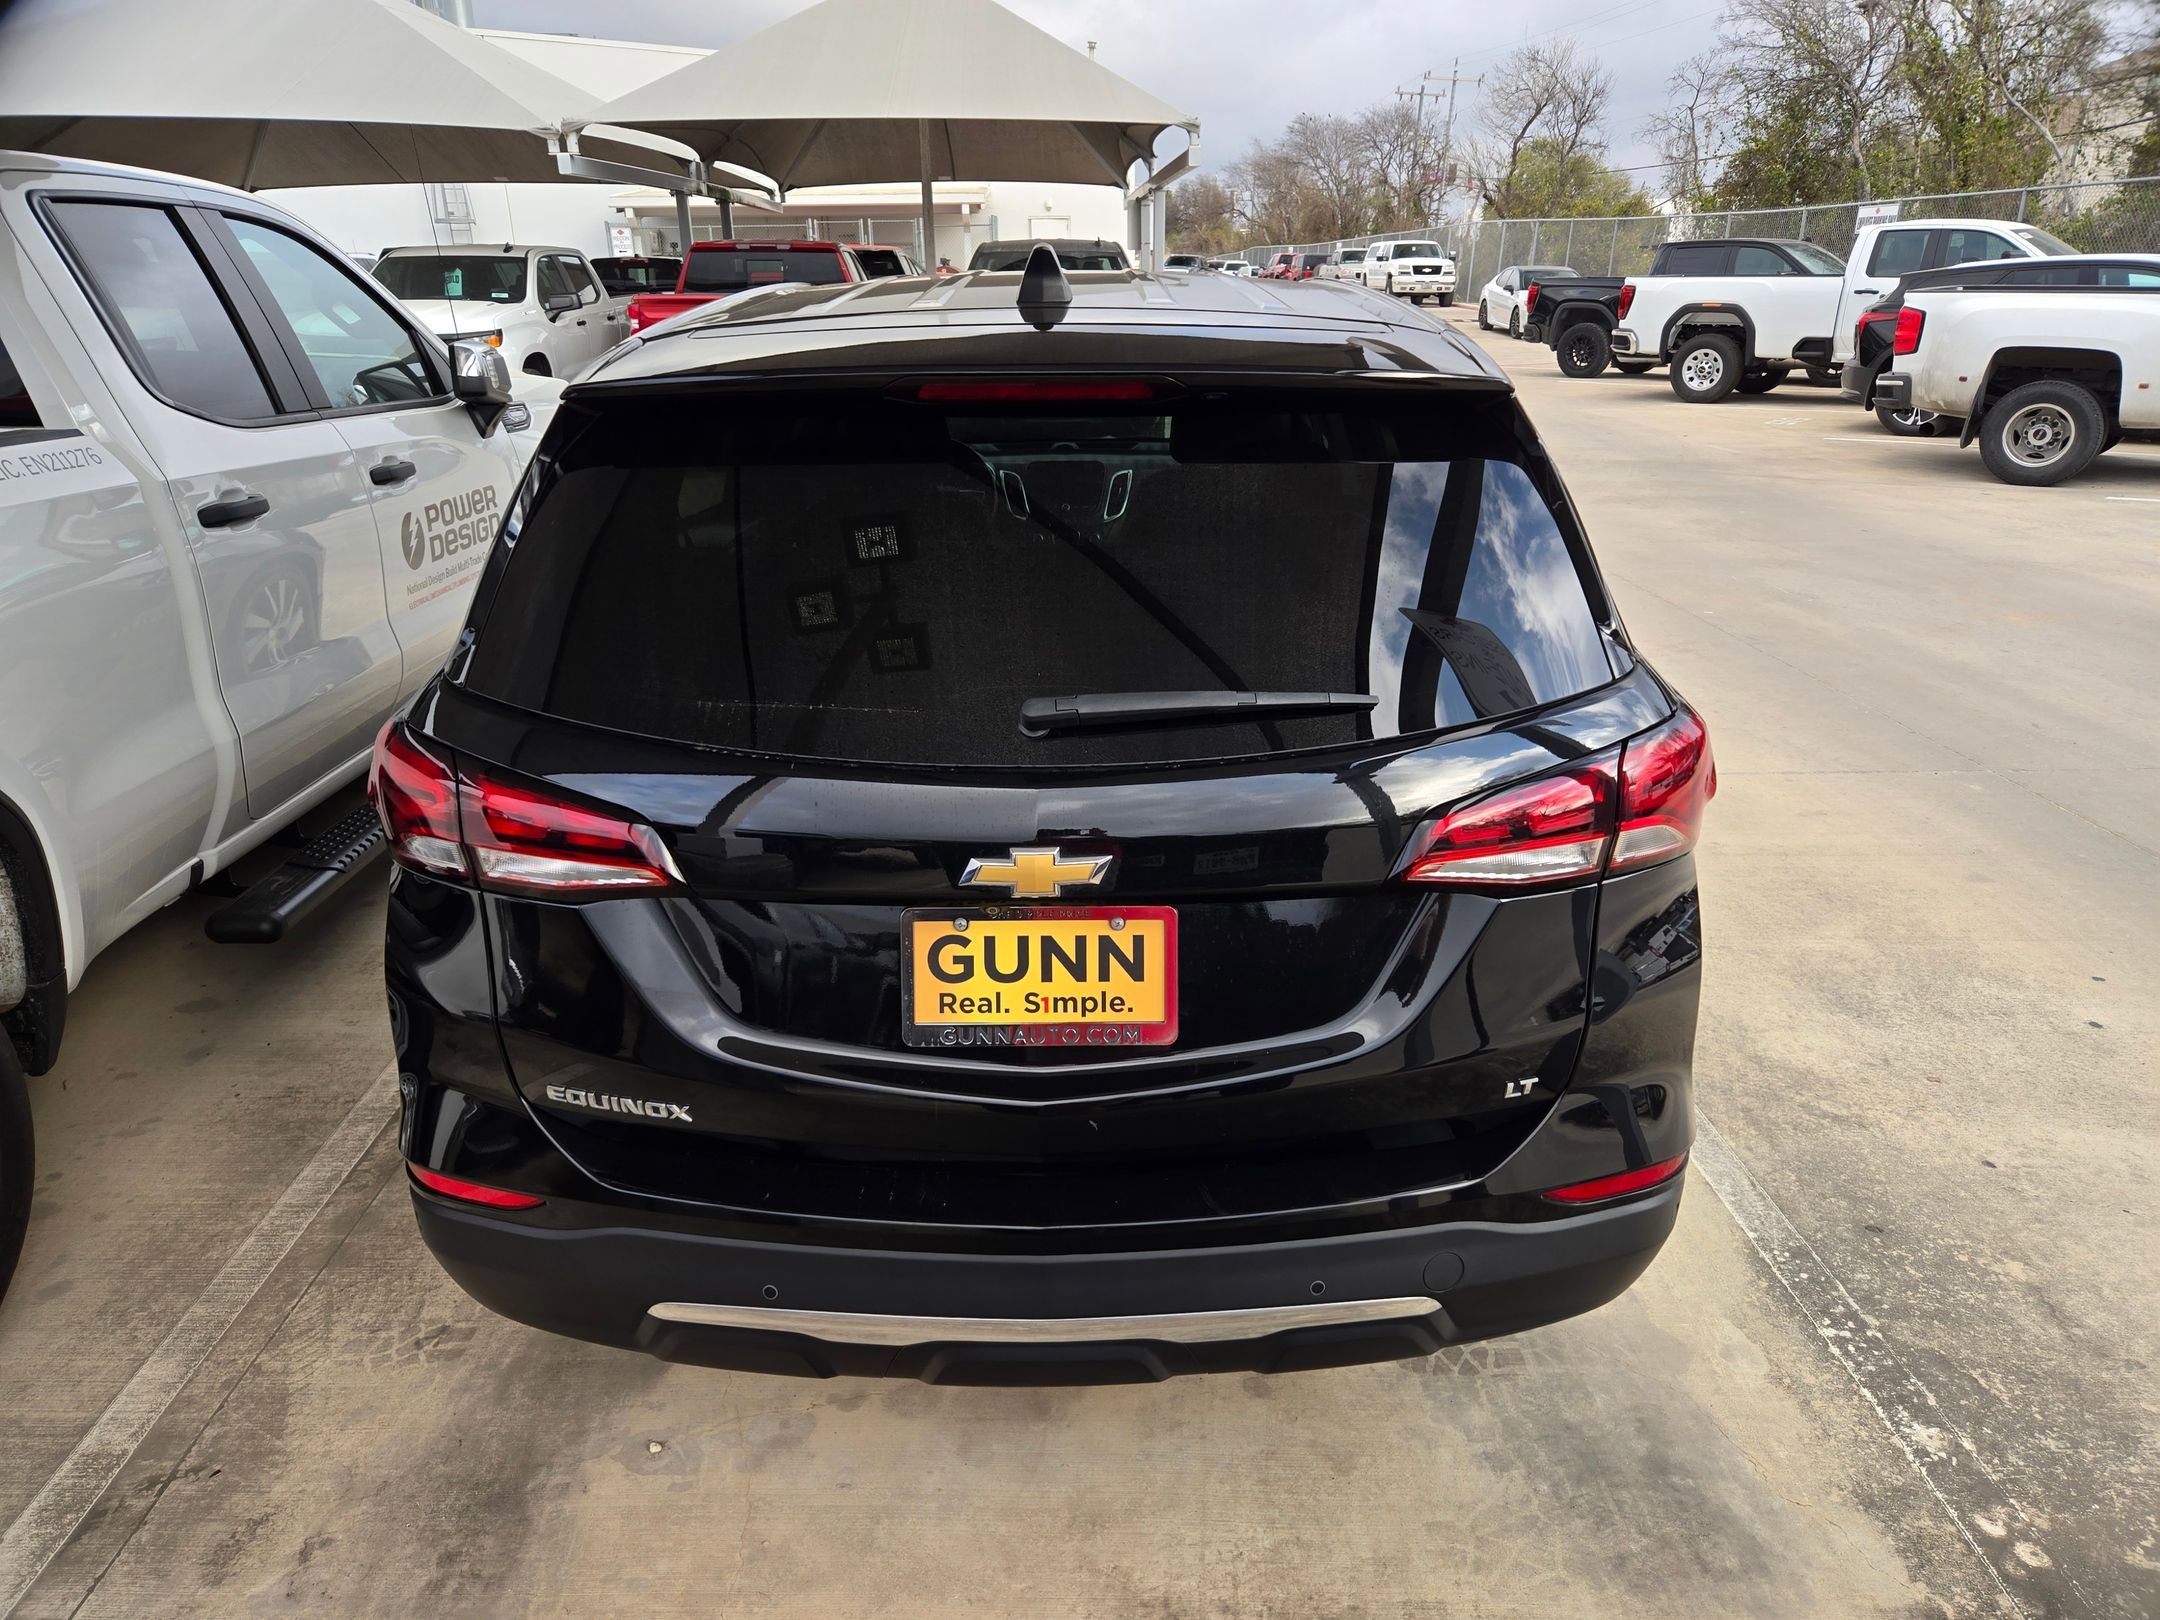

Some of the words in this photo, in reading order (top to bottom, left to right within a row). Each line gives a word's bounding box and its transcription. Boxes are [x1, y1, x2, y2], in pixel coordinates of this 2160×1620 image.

[927, 934, 1145, 984] GUNN
[939, 991, 1010, 1014] Real.
[940, 1026, 1141, 1045] GUNNAUTOCOM
[1504, 1076, 1539, 1099] LT
[546, 1084, 693, 1123] EQUINOX
